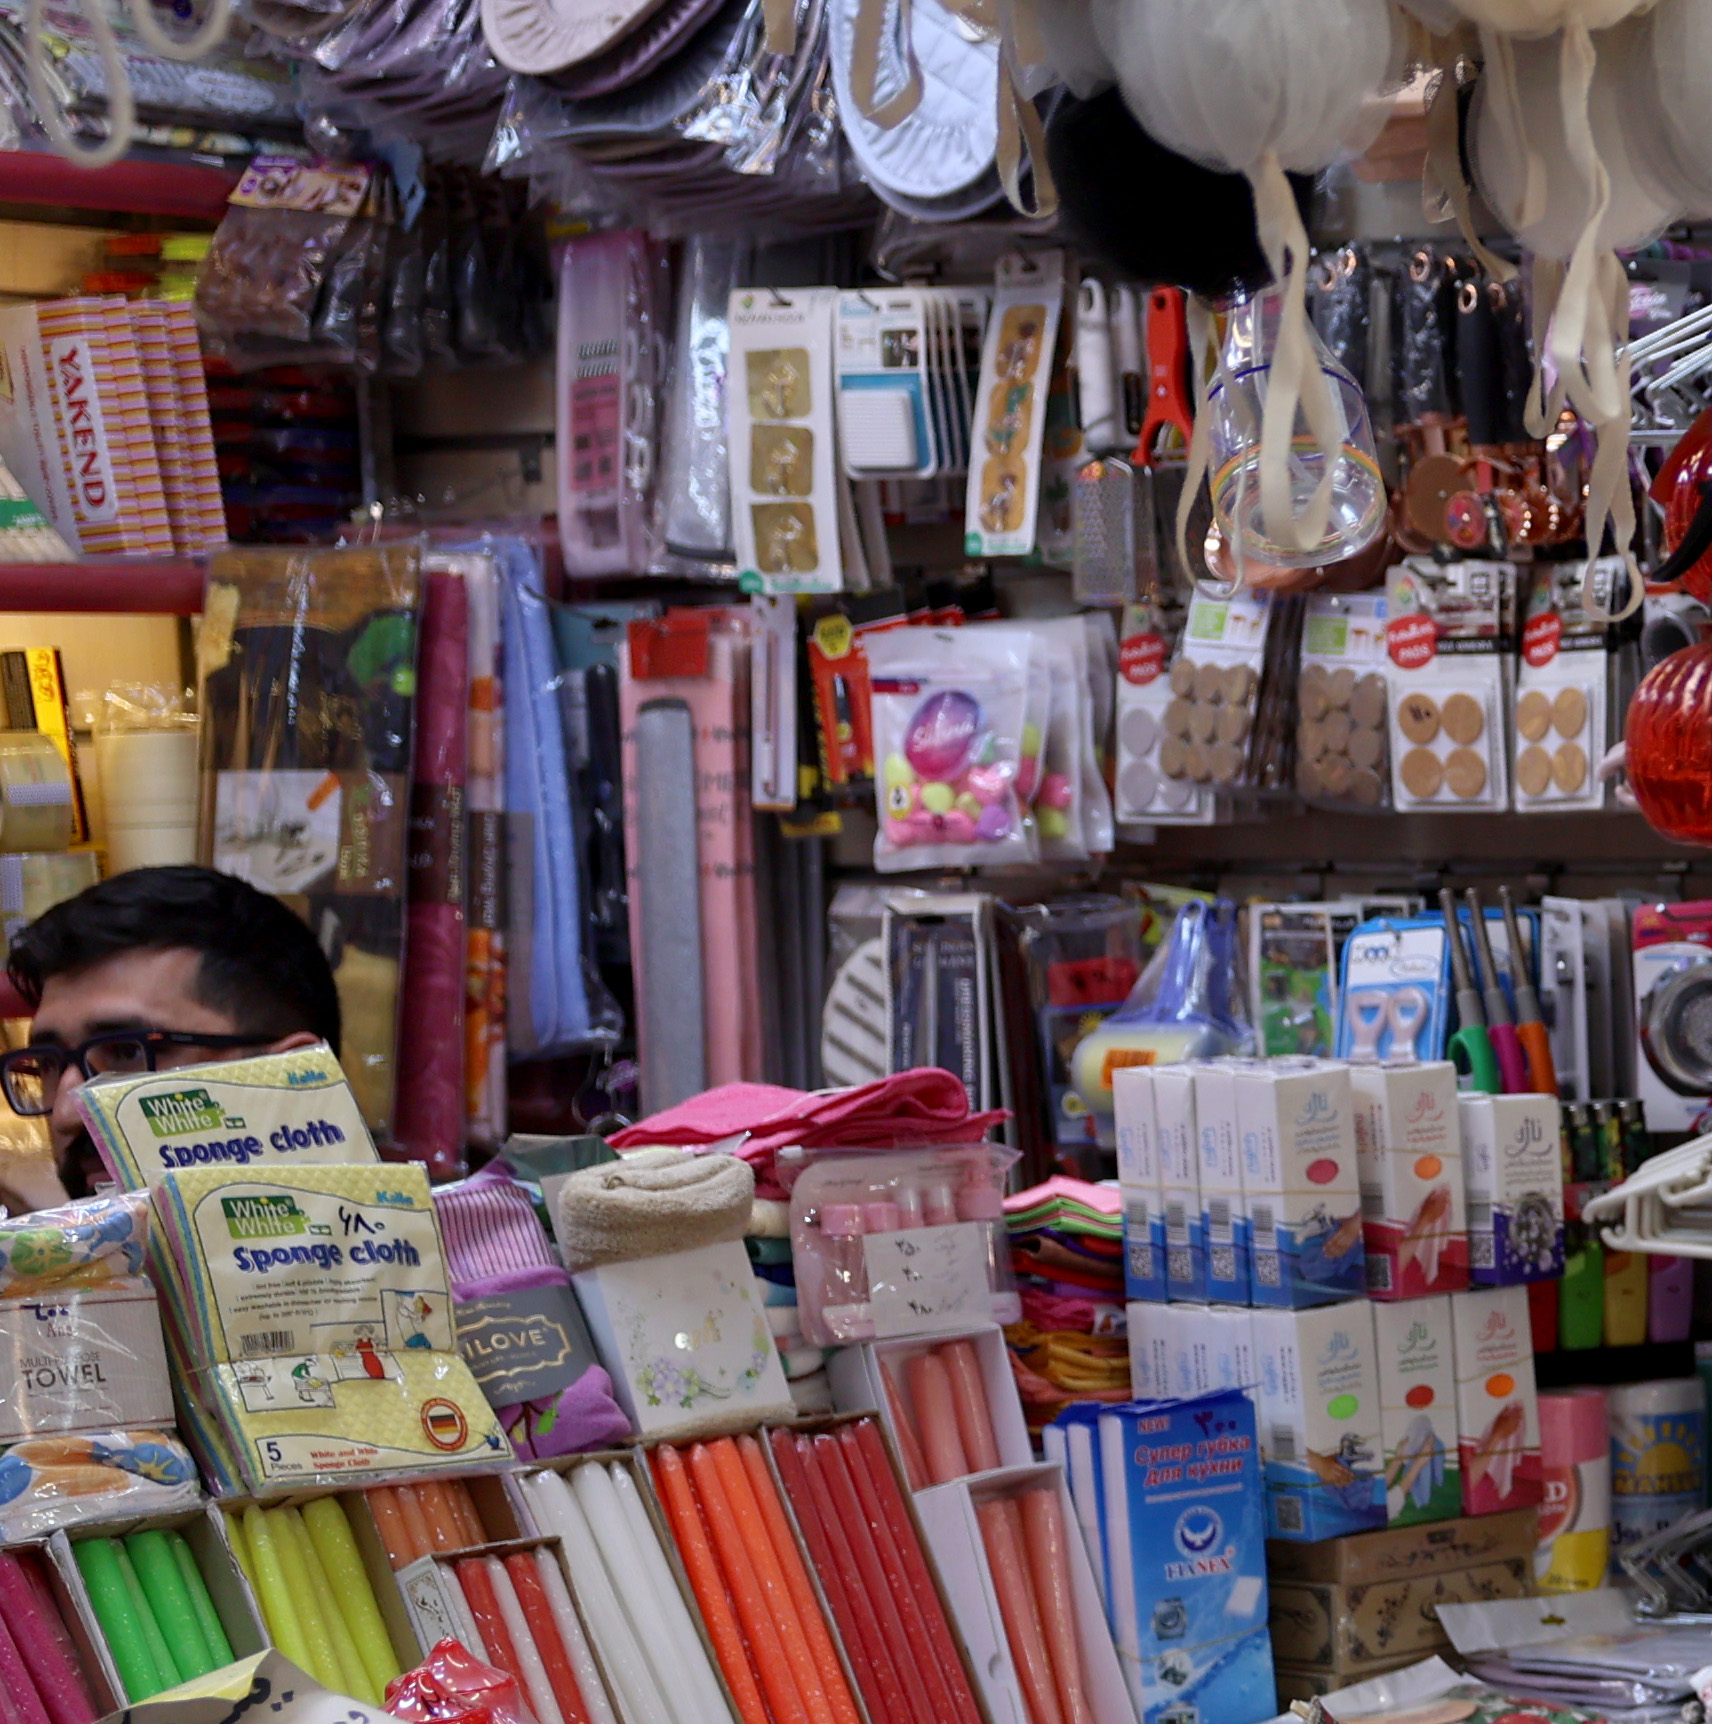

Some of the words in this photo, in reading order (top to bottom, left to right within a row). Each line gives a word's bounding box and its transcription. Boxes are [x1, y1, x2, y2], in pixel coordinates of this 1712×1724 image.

[59, 345, 106, 508] YAKEND
[147, 1096, 207, 1117] White
[154, 1110, 213, 1134] White
[158, 1133, 264, 1168] Sponge
[269, 1118, 346, 1152] cloth
[230, 1198, 291, 1217] White
[235, 1215, 296, 1234] White
[232, 1244, 343, 1274] Sponge
[349, 1239, 421, 1268] cloth
[22, 1363, 106, 1390] TOWEL
[267, 1441, 281, 1462] 5
[1135, 1443, 1194, 1466] Супер
[1196, 1435, 1252, 1459] губка
[270, 1460, 303, 1471] Pieces
[1186, 1458, 1244, 1482] кухни
